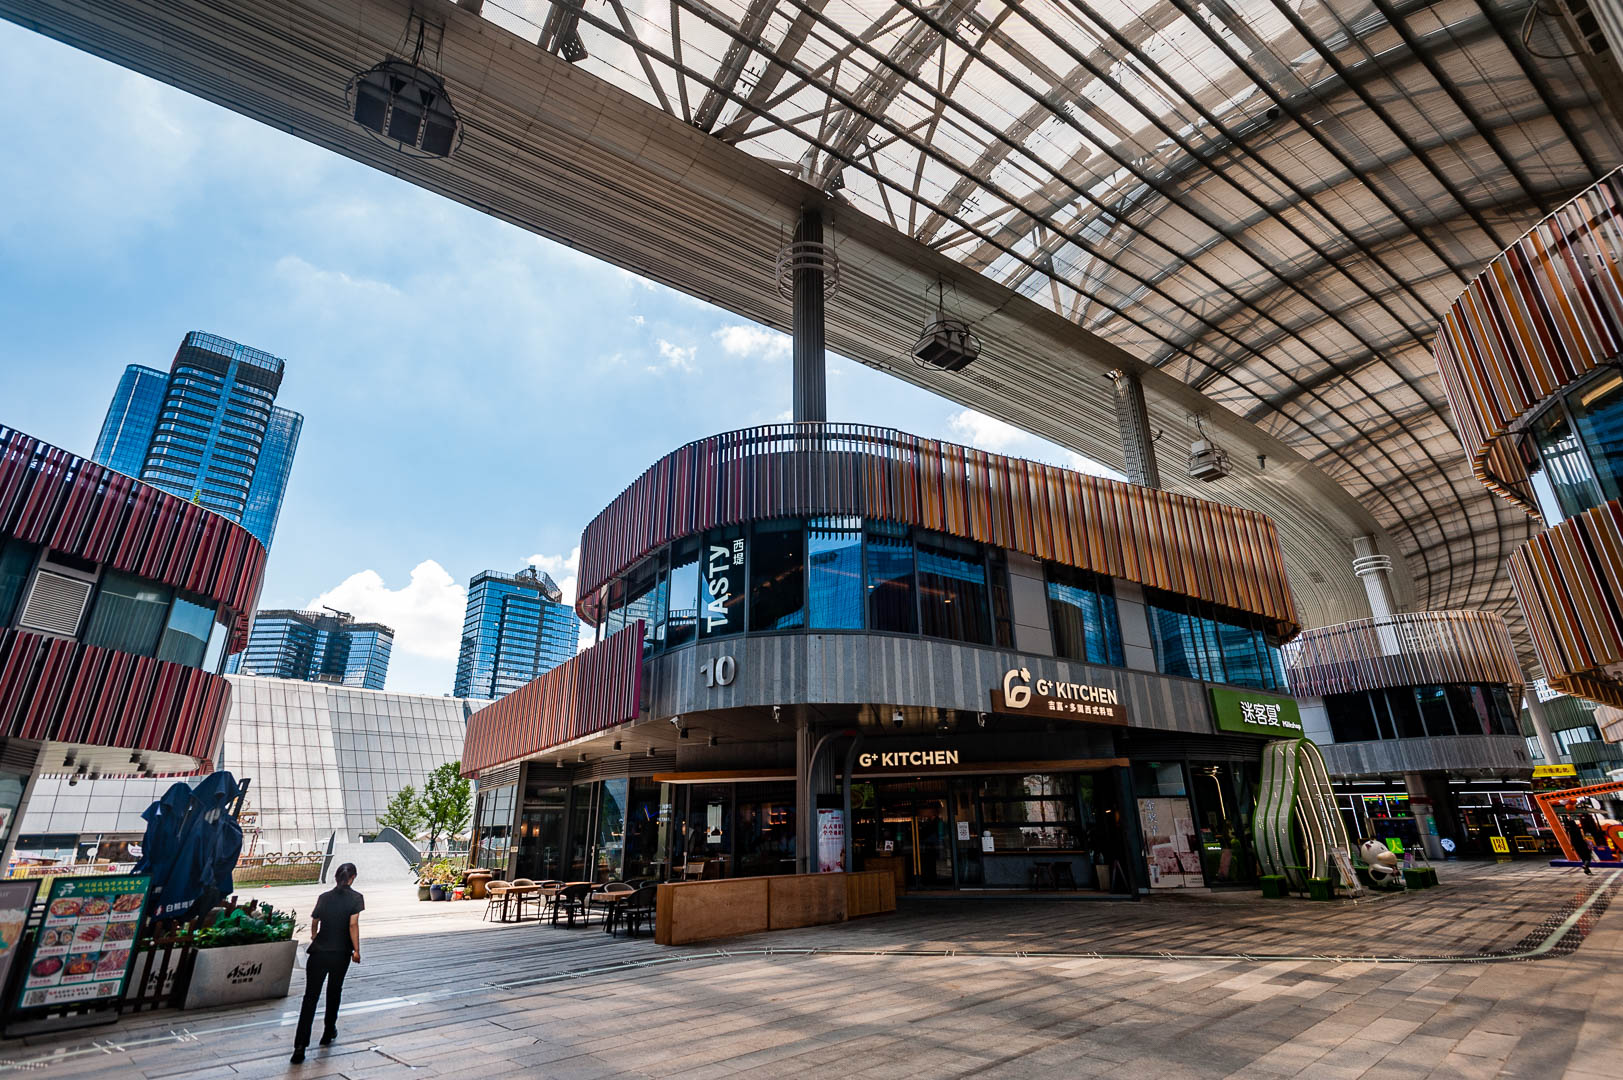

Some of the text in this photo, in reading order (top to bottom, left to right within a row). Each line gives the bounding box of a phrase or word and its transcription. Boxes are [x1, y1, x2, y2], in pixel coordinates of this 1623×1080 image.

[733, 538, 745, 566] 西堤
[700, 655, 736, 689] 10
[1056, 681, 1118, 705] KITCHEN
[1240, 701, 1280, 727] 迷客夏
[881, 750, 959, 766] KITCHEN
[227, 962, 263, 979] Asahi
